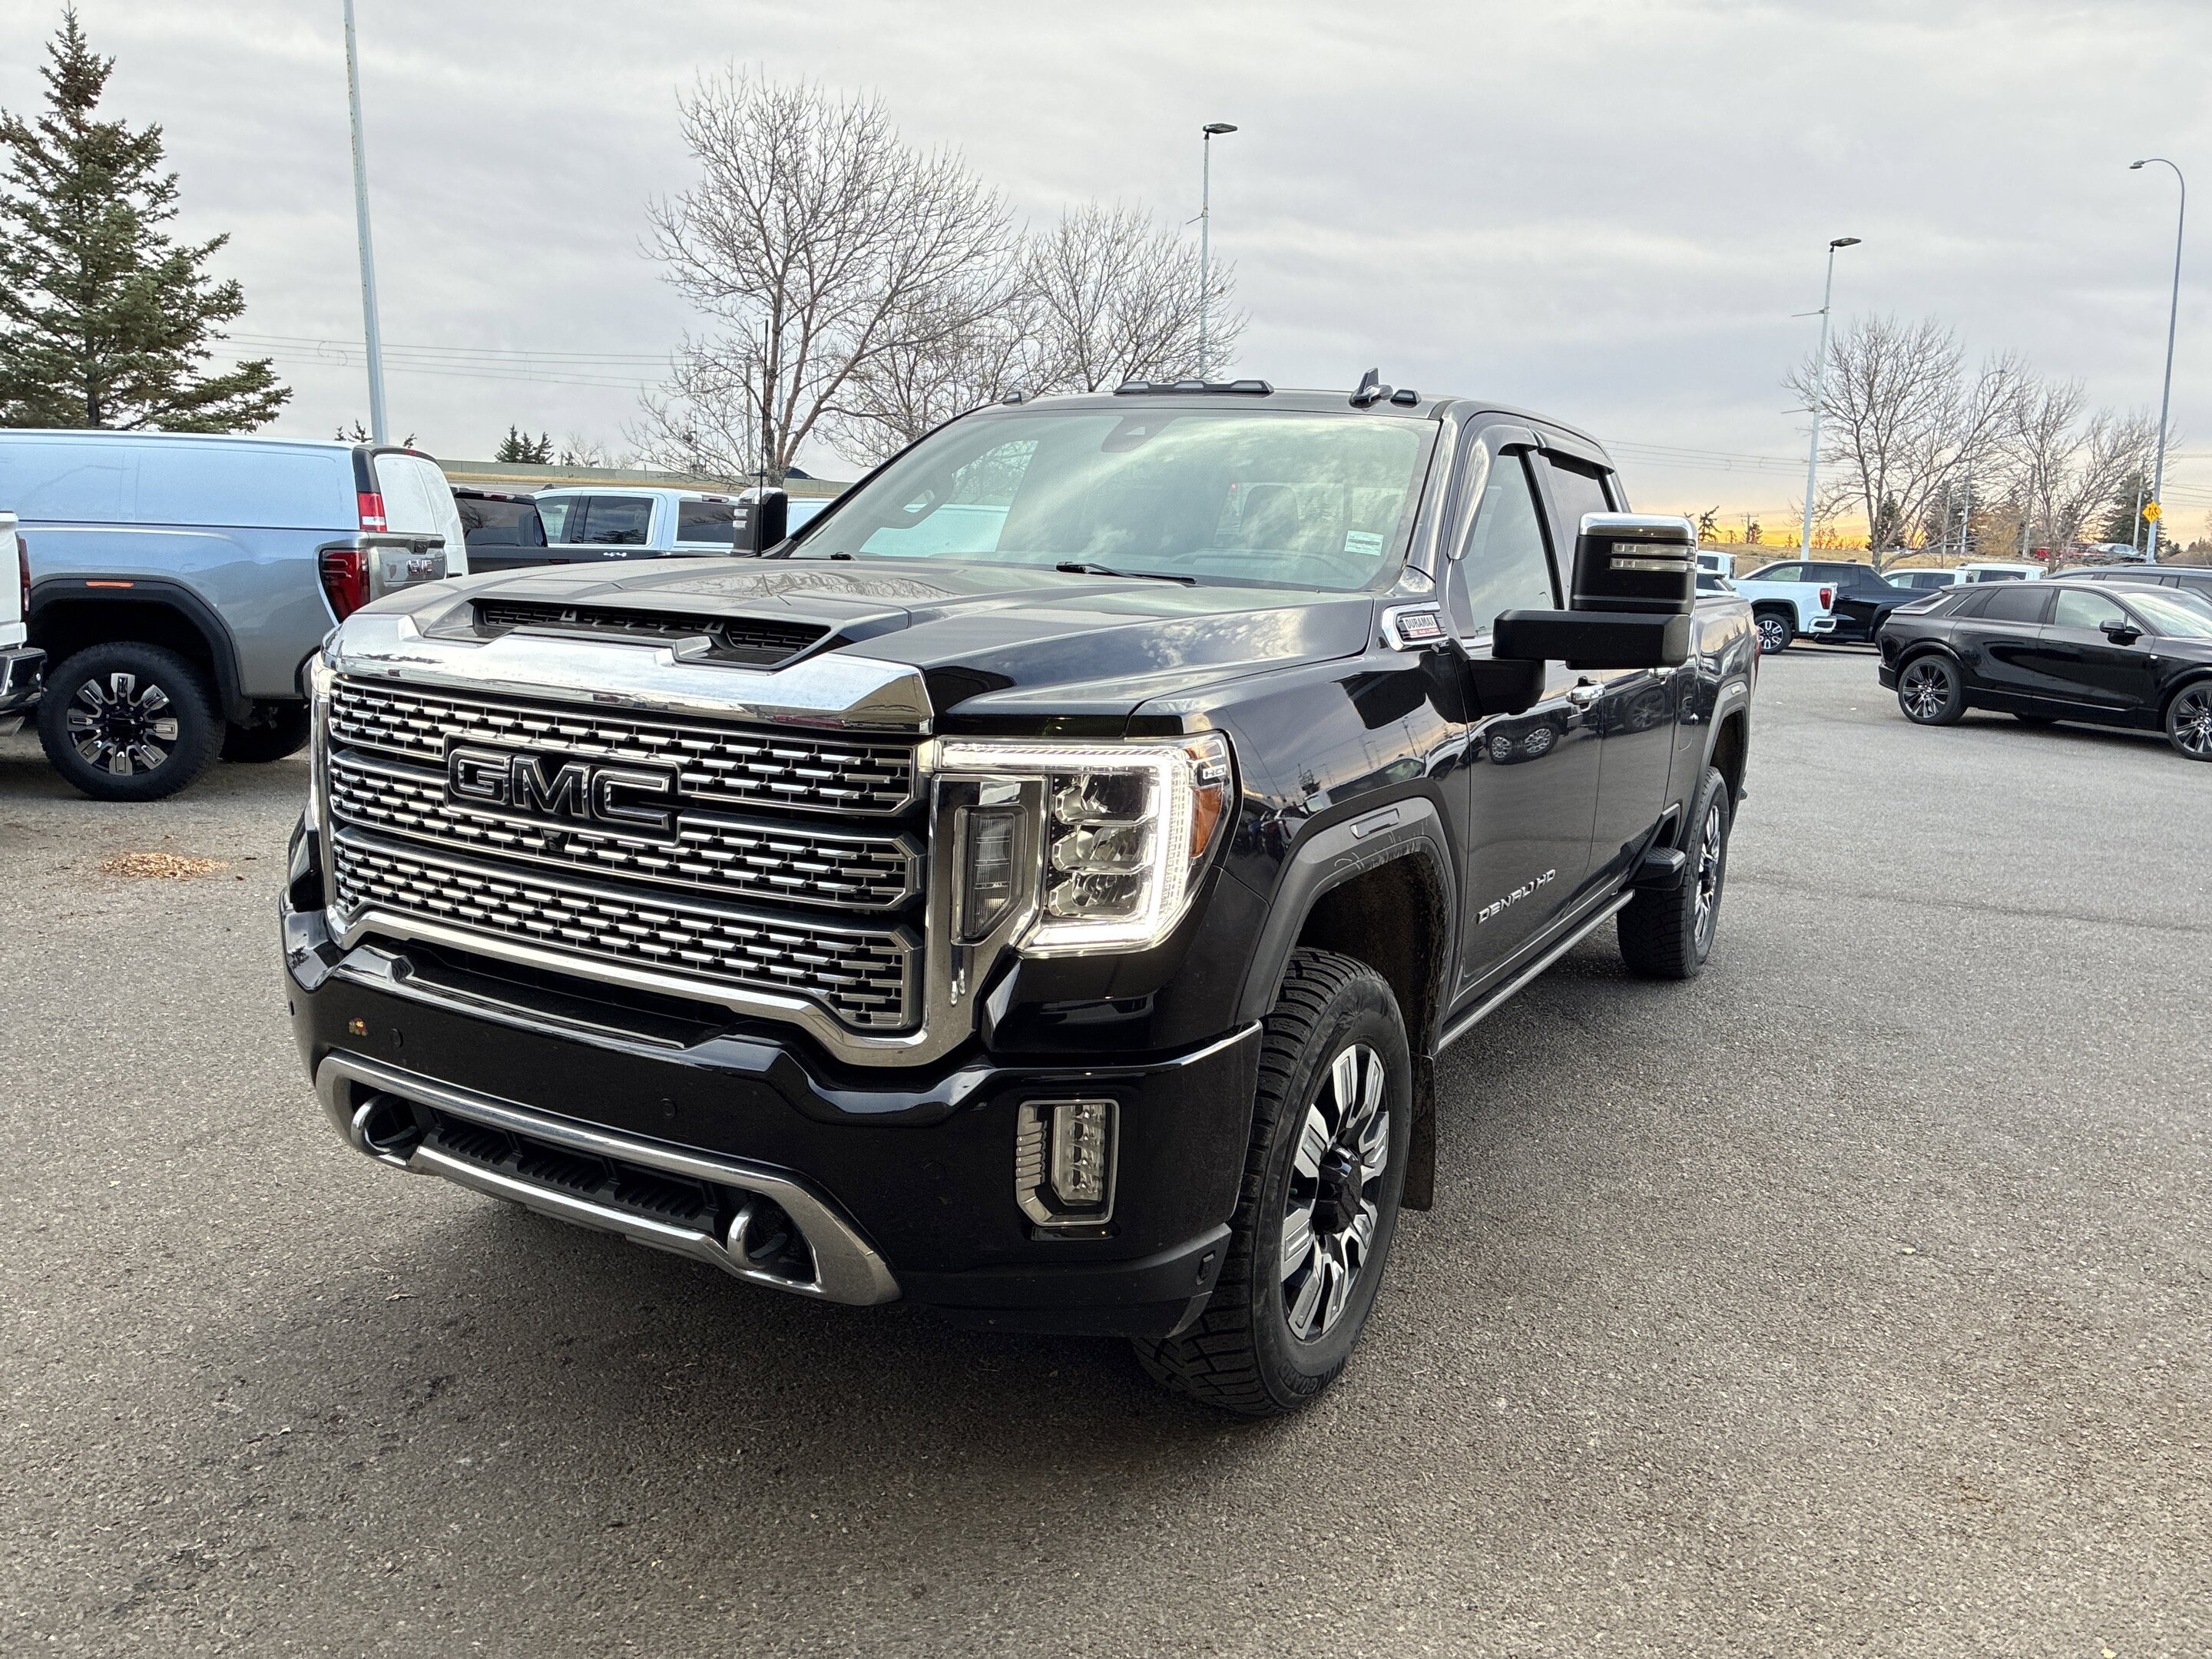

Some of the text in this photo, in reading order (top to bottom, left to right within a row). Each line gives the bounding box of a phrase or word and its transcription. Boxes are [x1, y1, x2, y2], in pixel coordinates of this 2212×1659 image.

[1405, 616, 1436, 629] DURAMAX
[449, 746, 671, 831] GMC
[1475, 869, 1556, 925] DENALI HD
